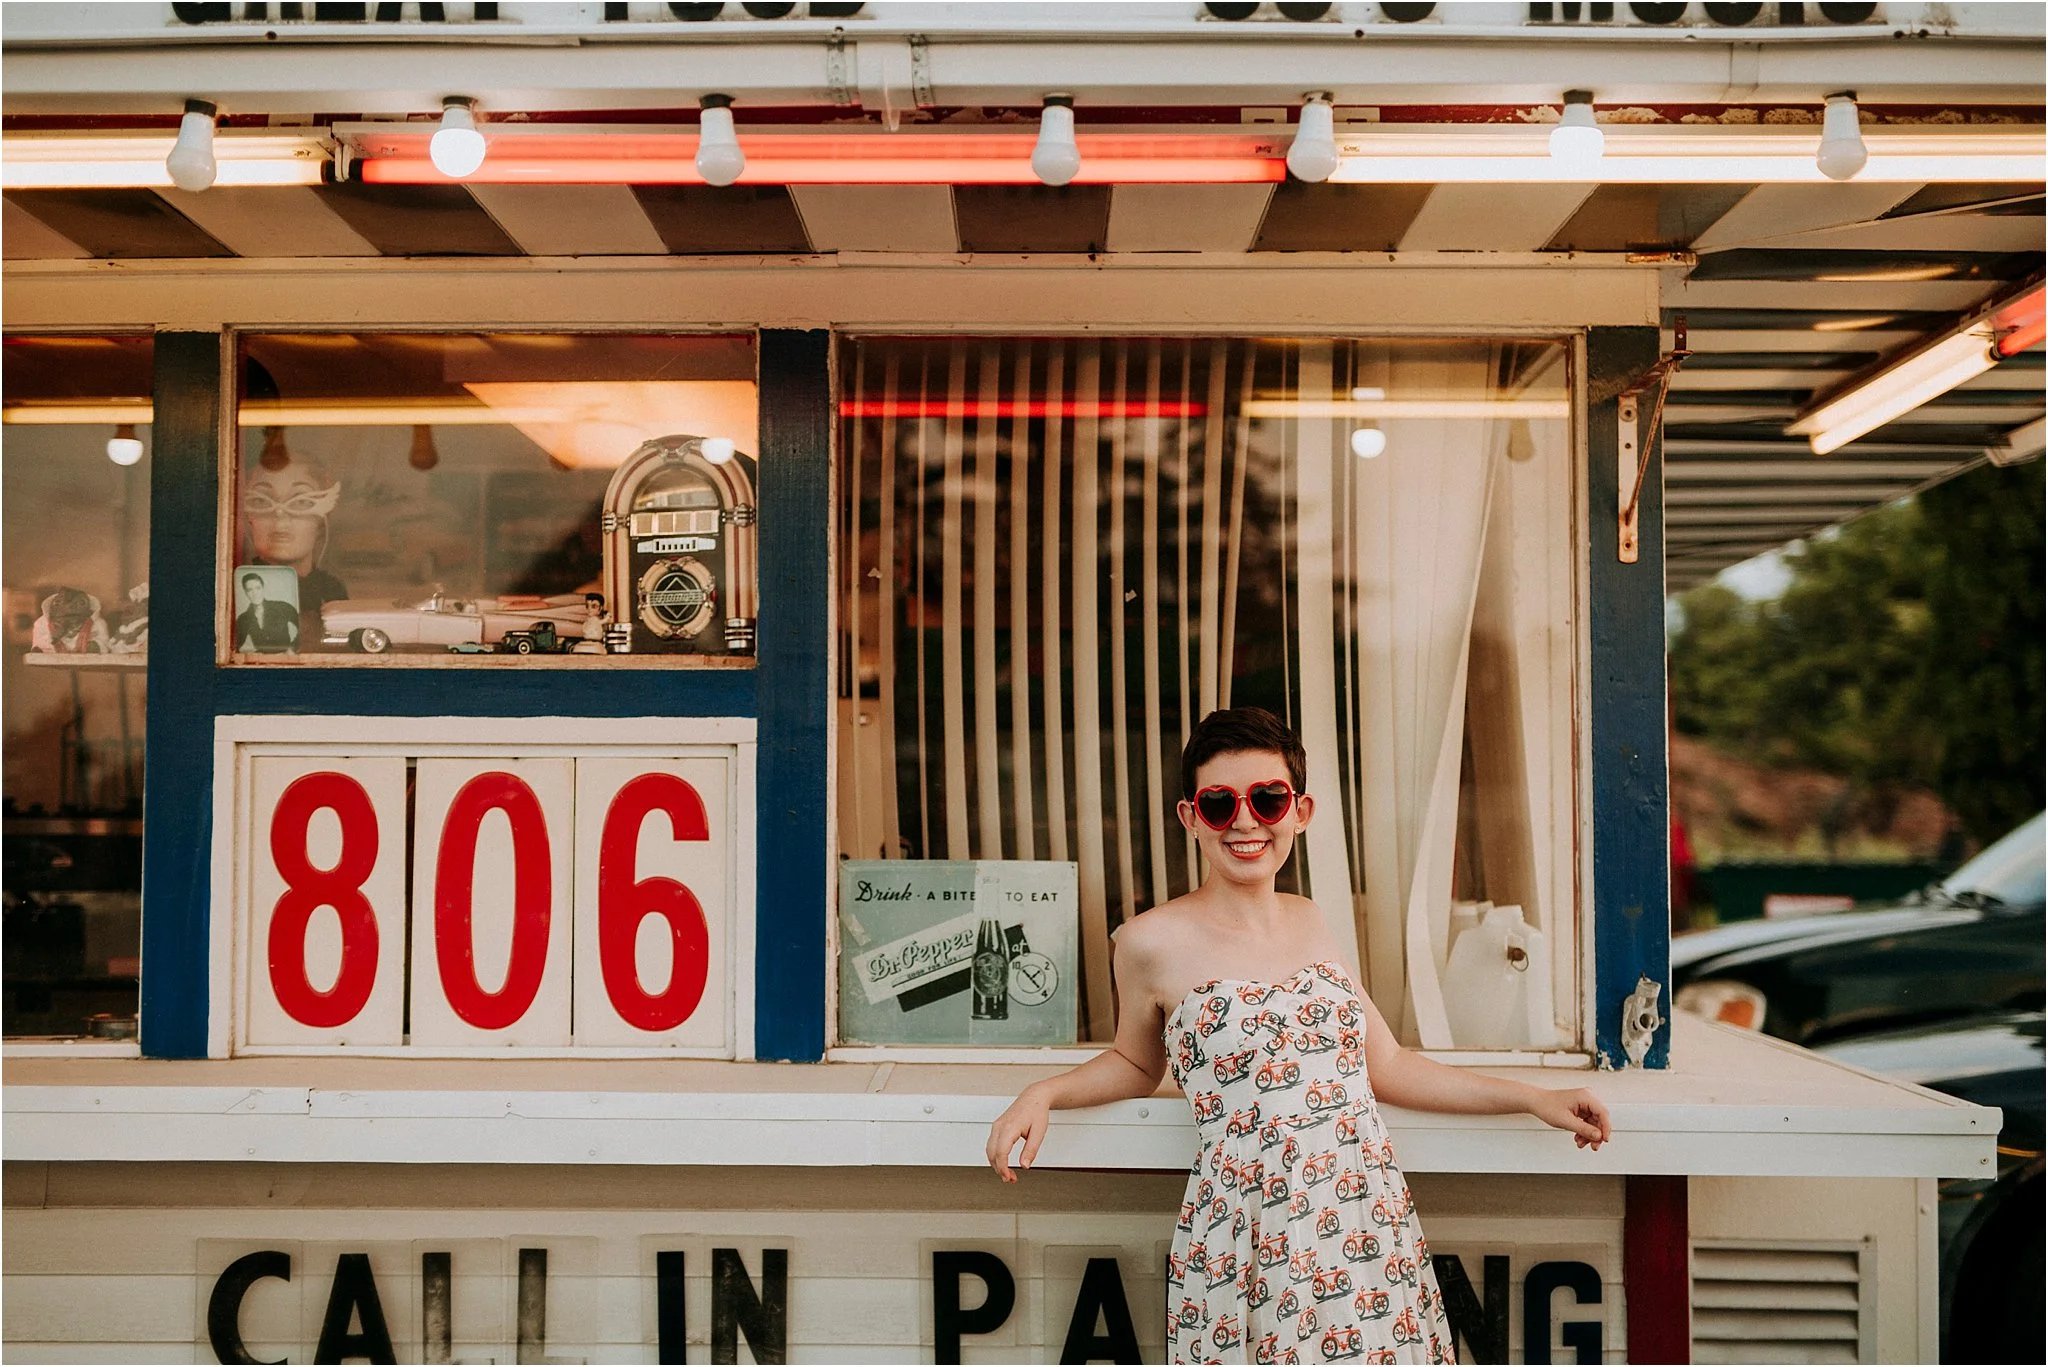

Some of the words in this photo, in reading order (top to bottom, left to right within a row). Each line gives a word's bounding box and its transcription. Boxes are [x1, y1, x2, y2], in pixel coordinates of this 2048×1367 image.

[855, 879, 913, 902] Drink
[926, 891, 936, 901] A
[943, 891, 976, 901] BITE
[1006, 892, 1024, 902] TO
[1031, 892, 1059, 902] EAT
[267, 771, 710, 1032] 806
[901, 929, 974, 969] Pepper
[1011, 939, 1028, 955] at
[1012, 961, 1021, 970] 10
[1044, 961, 1050, 970] 2
[1041, 990, 1049, 998] 4
[207, 1249, 587, 1366] CALL
[656, 1248, 789, 1366] IN
[932, 1250, 1604, 1366] PANG
